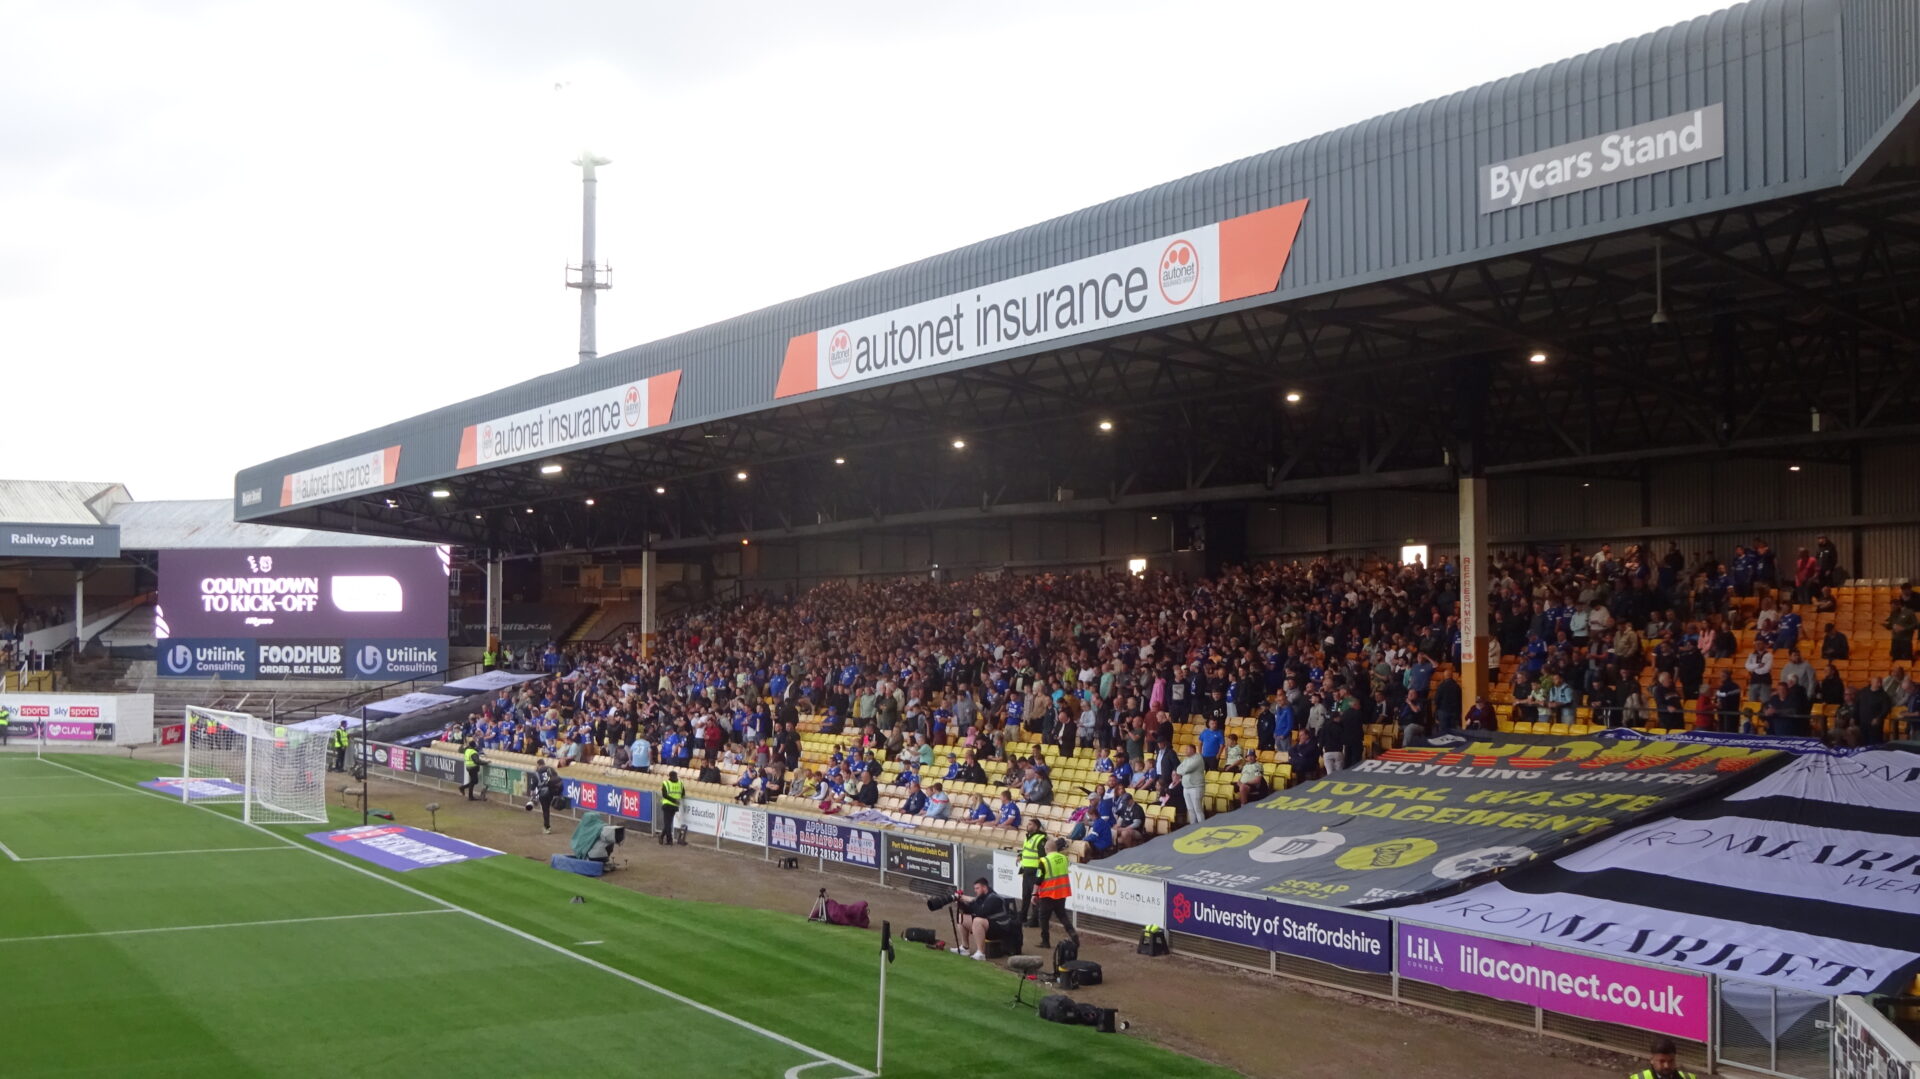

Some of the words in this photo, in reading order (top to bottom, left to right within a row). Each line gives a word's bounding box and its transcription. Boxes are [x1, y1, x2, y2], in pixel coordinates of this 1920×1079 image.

[1490, 150, 1593, 206] Bycars
[1600, 110, 1703, 173] Stand
[1162, 262, 1195, 281] autonet
[855, 316, 964, 374] autonet
[976, 265, 1148, 349] insurance
[494, 420, 544, 457] autonet
[548, 400, 621, 444] insurance
[301, 475, 330, 499] autonet
[331, 463, 370, 494] insurance
[11, 533, 58, 548] Railway
[59, 535, 94, 546] Stand
[201, 577, 318, 594] COUNTDOWN
[202, 594, 229, 612] TO
[230, 594, 318, 612] KICK-OFF
[196, 646, 245, 661] Utilink
[259, 645, 341, 664] FOODHUB
[386, 646, 437, 662] Utilink
[196, 662, 245, 674] Consulting
[259, 665, 292, 674] ORDER.
[294, 665, 311, 674] EAT.
[313, 666, 343, 674] ENJOY.
[386, 662, 437, 674] Consulting
[22, 707, 49, 717] sports
[70, 708, 98, 718] sports
[1353, 759, 1541, 781] RECYCLING
[567, 781, 581, 804] sky
[582, 784, 596, 804] bet
[607, 788, 622, 812] sky
[623, 791, 639, 811] bet
[1306, 780, 1453, 802] TOTAL
[691, 806, 716, 820] Education
[1256, 795, 1615, 834] MANAGEMENT
[805, 820, 839, 837] APPLIED
[799, 830, 844, 849] RADIATORS
[800, 844, 819, 858] 01782
[820, 848, 844, 862] 281628
[1070, 871, 1117, 896] YARD
[1195, 870, 1261, 883] TRADE
[1280, 879, 1350, 895] SCRAP
[1087, 895, 1117, 907] MARRIOTT
[1120, 891, 1161, 906] SCHOLARS
[1193, 901, 1261, 936] University
[1263, 917, 1279, 935] of
[1282, 917, 1381, 955] Staffordshire
[1460, 945, 1684, 1017] lilaconnect.co.uk
